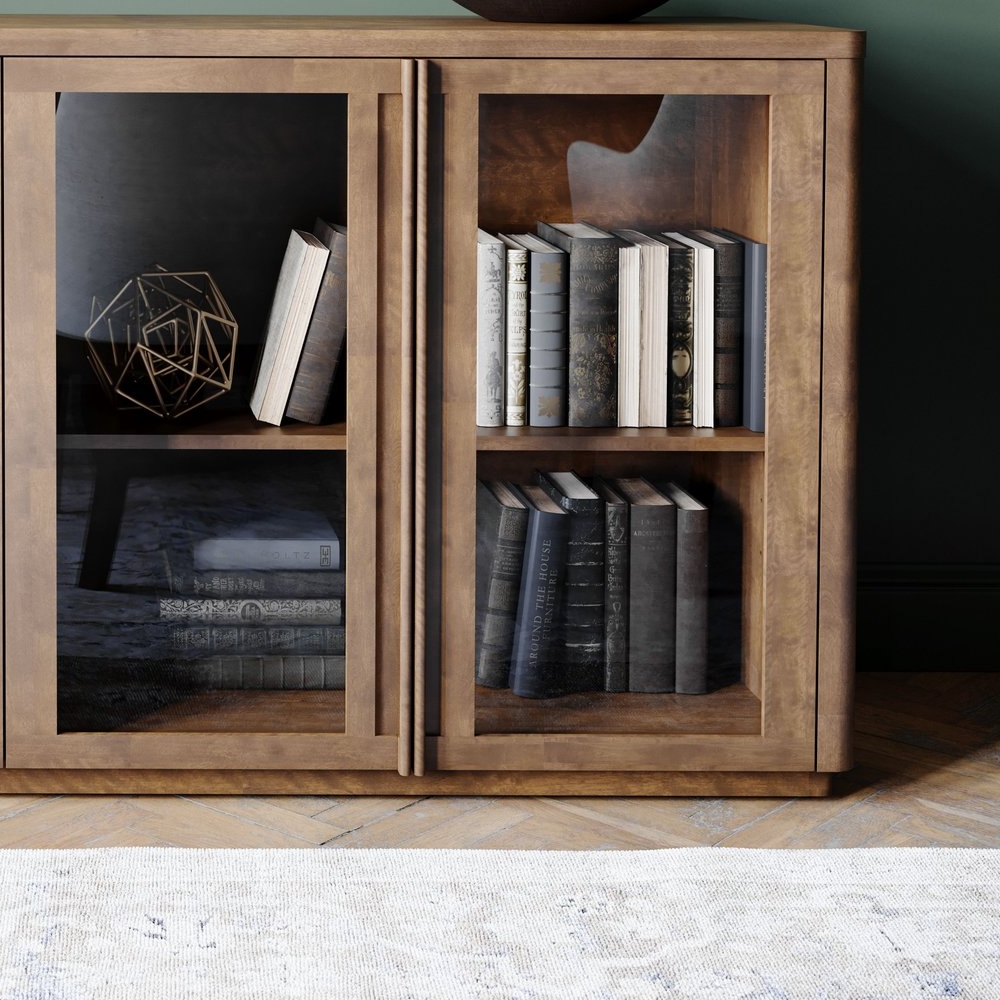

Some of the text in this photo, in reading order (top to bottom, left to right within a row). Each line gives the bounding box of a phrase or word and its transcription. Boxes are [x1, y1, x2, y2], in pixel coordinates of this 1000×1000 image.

[529, 539, 552, 668] AROUND THE HOUSE
[543, 569, 558, 640] FURNITURE
